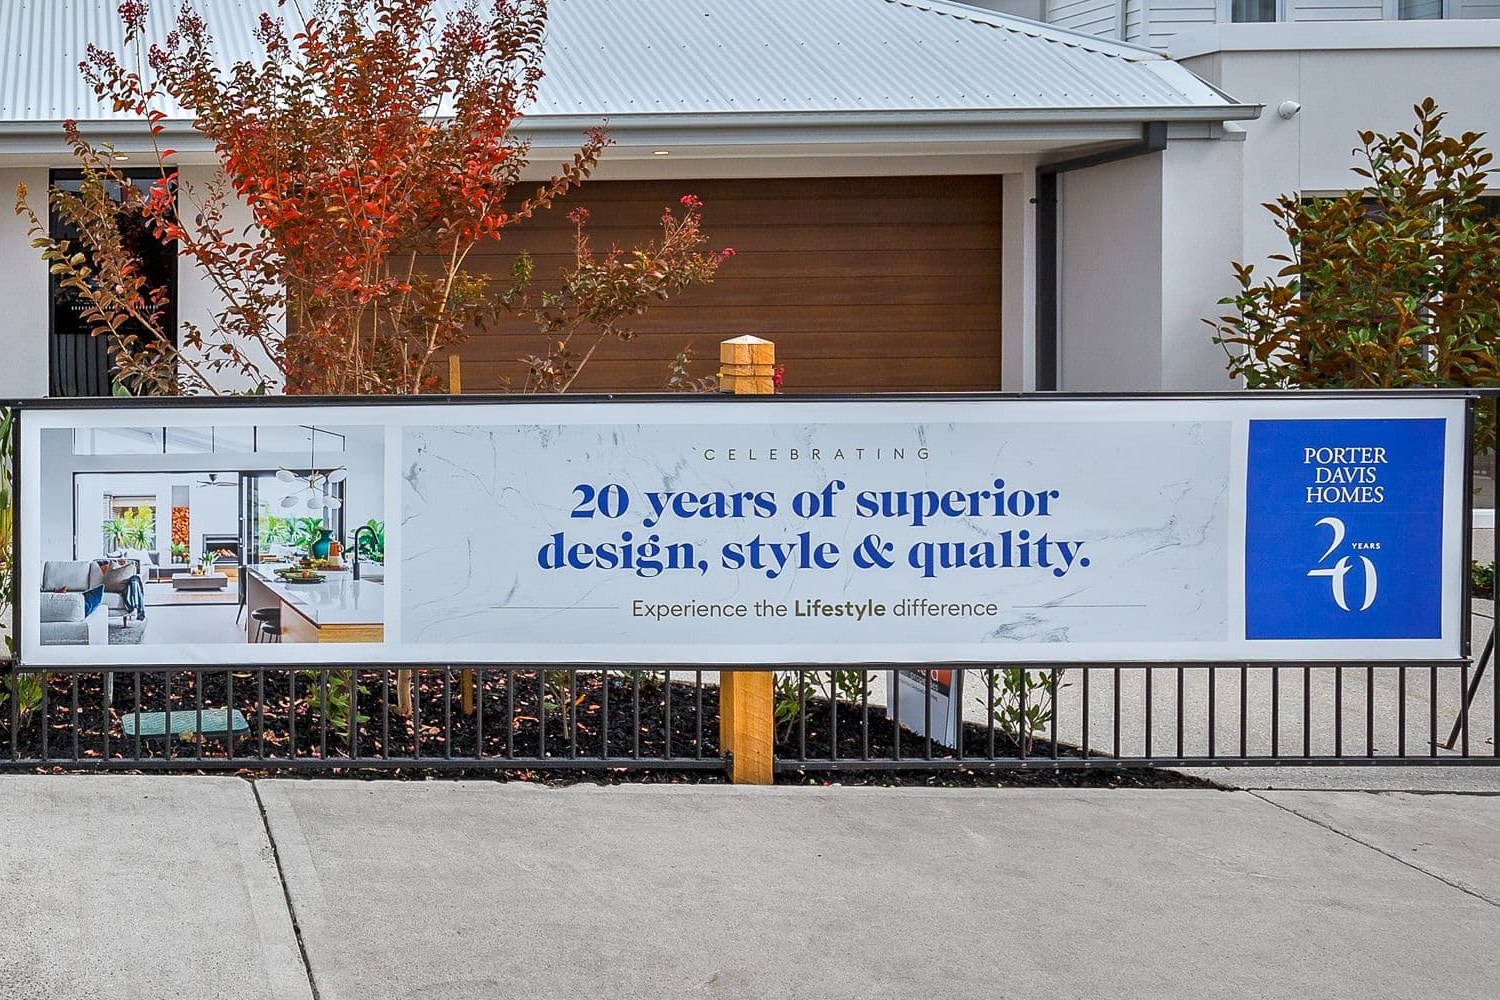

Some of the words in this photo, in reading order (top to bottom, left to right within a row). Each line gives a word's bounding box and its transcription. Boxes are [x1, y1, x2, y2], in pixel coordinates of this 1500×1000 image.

[703, 447, 931, 461] CELEBRATING
[1303, 447, 1388, 464] PORTER
[1314, 467, 1377, 483] DAVIS
[1306, 486, 1384, 503] HOMES
[570, 484, 629, 518] 20
[643, 490, 777, 528] years
[792, 480, 845, 518] of
[855, 479, 1060, 526] superior
[1351, 542, 1381, 550] YEARS
[537, 531, 709, 577] design,
[722, 531, 840, 580] style
[852, 535, 896, 569] &
[907, 530, 1091, 579] quality.
[631, 599, 749, 620] Experience
[754, 599, 788, 618] the
[794, 599, 887, 620] Lifestyle
[892, 598, 999, 618] difference
